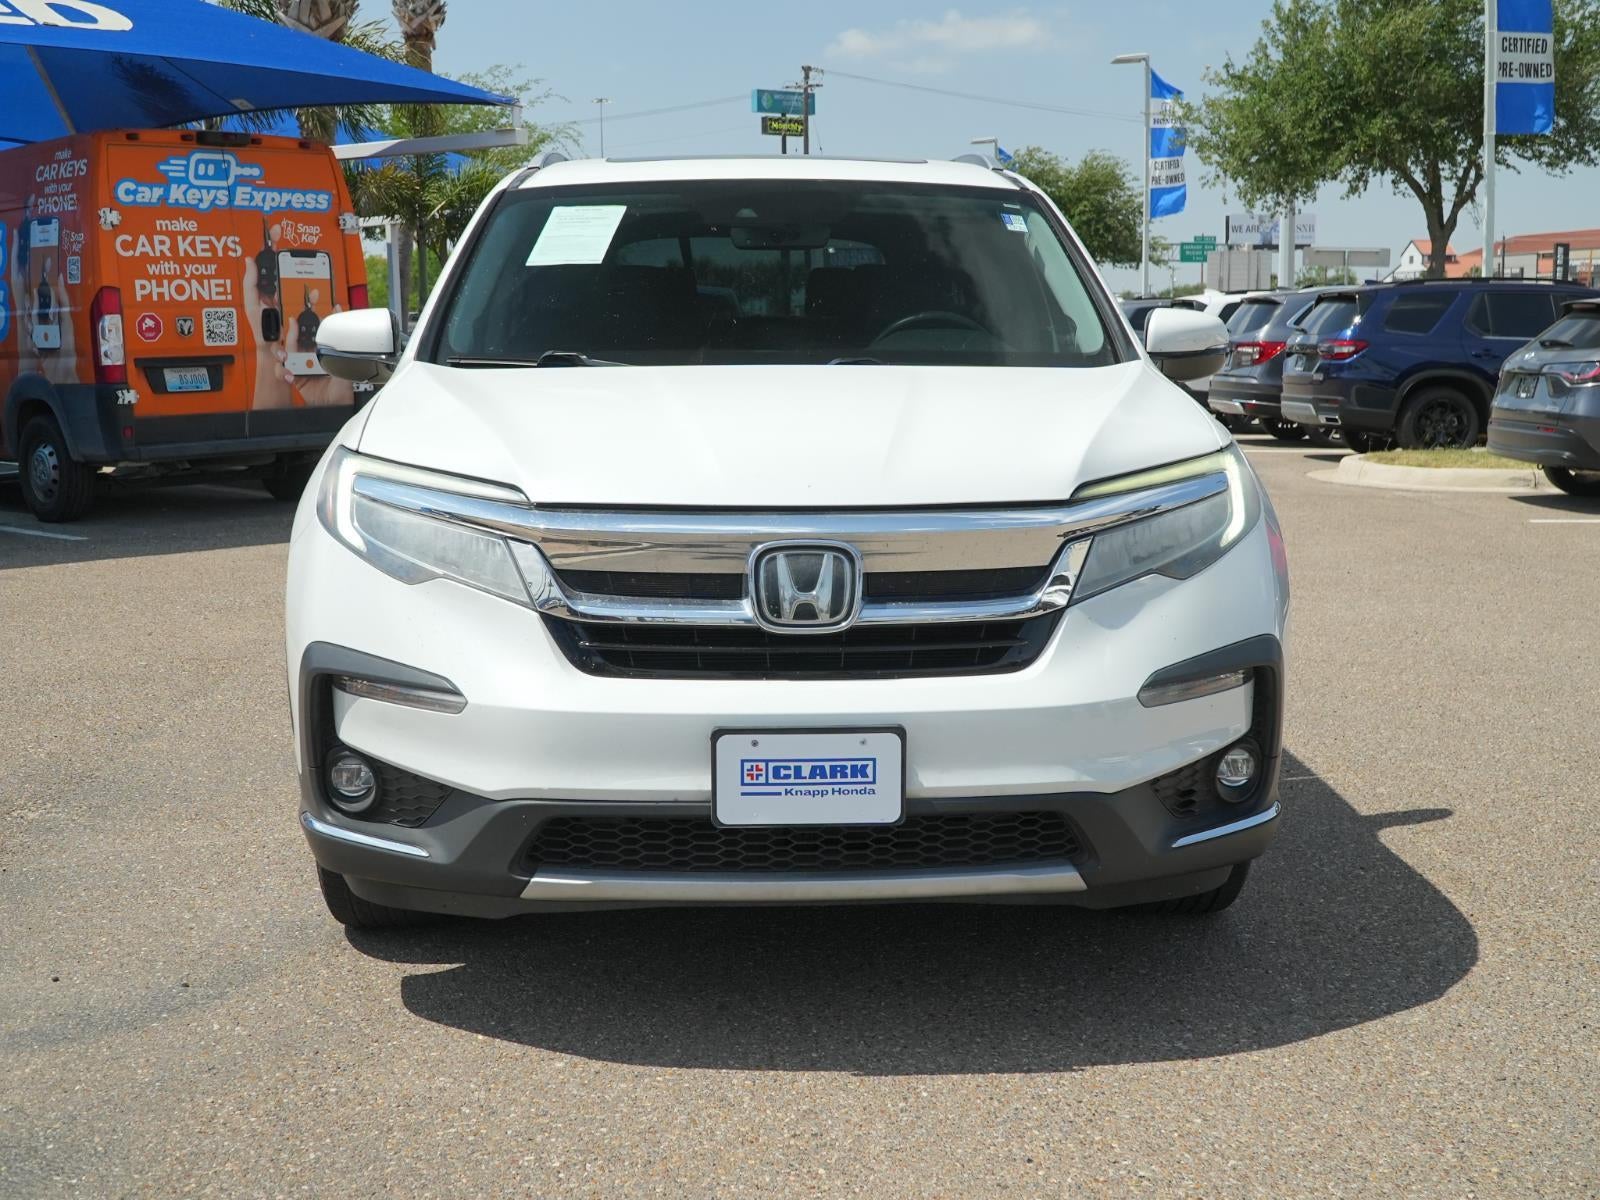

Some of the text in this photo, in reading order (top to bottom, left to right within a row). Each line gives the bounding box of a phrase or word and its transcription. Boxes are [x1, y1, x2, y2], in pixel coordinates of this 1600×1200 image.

[1501, 36, 1548, 54] CERTIFIED
[55, 148, 72, 160] make
[36, 158, 88, 182] CAR KEYS
[1151, 172, 1185, 185] PRE-OWNED
[58, 182, 72, 194] your
[117, 181, 330, 211] Car Keys Express
[37, 193, 77, 214] PHONE!
[156, 217, 198, 232] make
[297, 223, 321, 235] Snap
[1231, 224, 1243, 233] WE
[115, 235, 243, 258] CAR KEYS
[301, 233, 320, 245] Key
[147, 261, 217, 278] with your
[134, 279, 233, 302] PHONE!
[772, 763, 870, 780] CLARK
[784, 787, 876, 798] Knapp Honda
